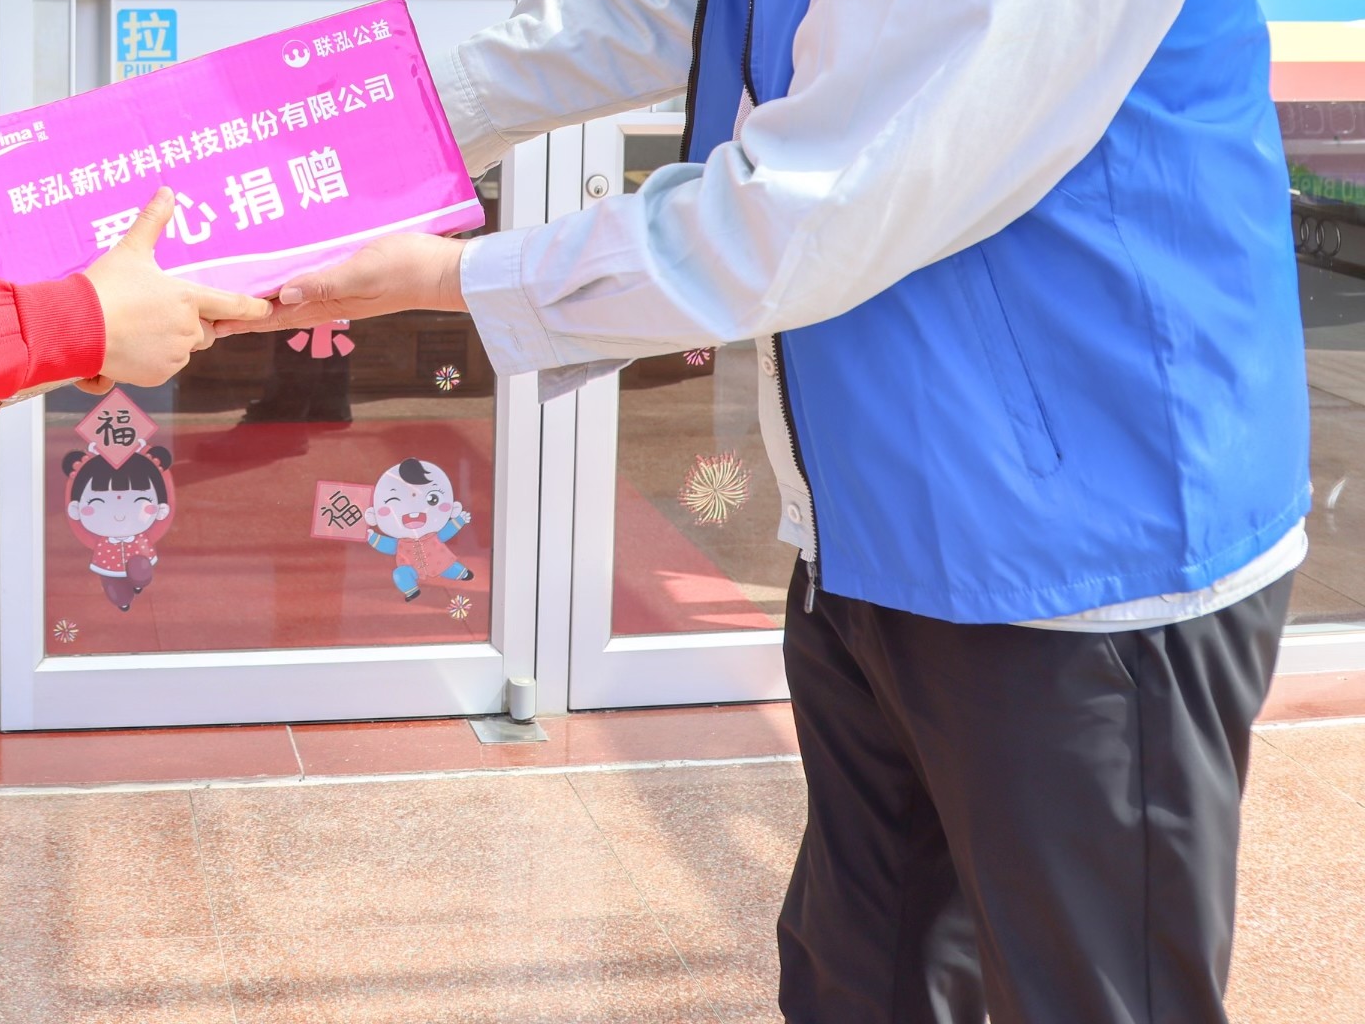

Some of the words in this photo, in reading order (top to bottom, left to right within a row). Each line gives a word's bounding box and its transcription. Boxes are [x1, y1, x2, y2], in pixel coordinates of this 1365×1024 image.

[123, 12, 171, 61] 拉
[313, 19, 392, 59] 联泓公益
[7, 74, 395, 216] 联泓新材料科技股份有限公司
[95, 409, 136, 448] 福
[321, 490, 363, 529] 福
